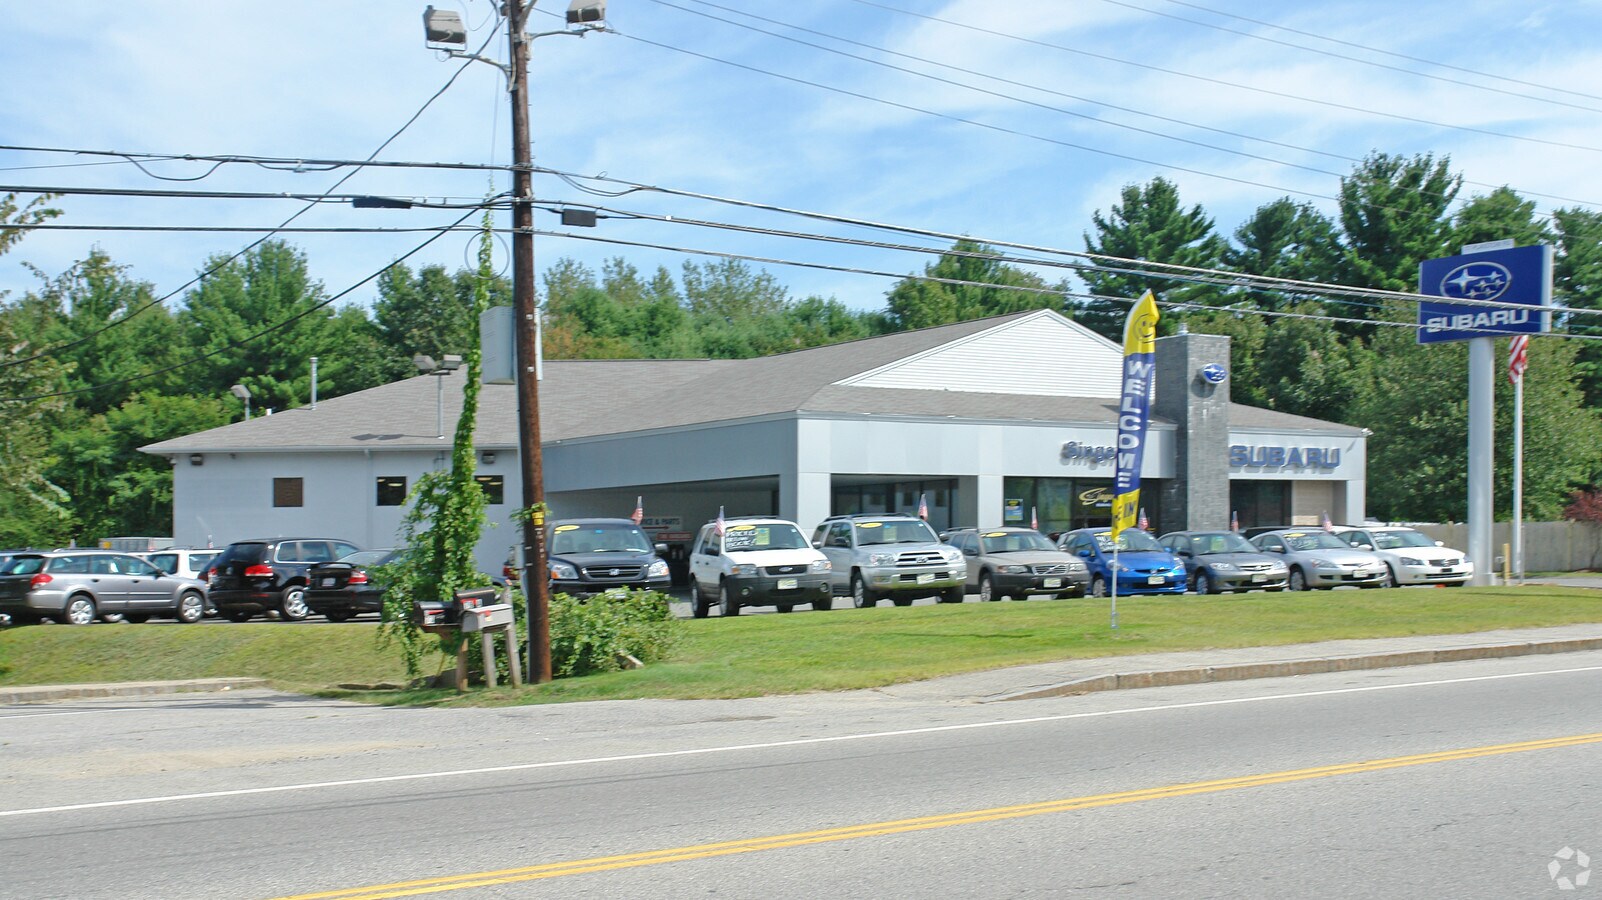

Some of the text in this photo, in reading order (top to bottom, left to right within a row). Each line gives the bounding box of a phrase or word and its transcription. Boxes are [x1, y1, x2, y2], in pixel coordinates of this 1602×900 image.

[1426, 309, 1529, 333] SUBARU
[1118, 360, 1152, 488] WELCOME
[1229, 445, 1340, 469] SUBARU
